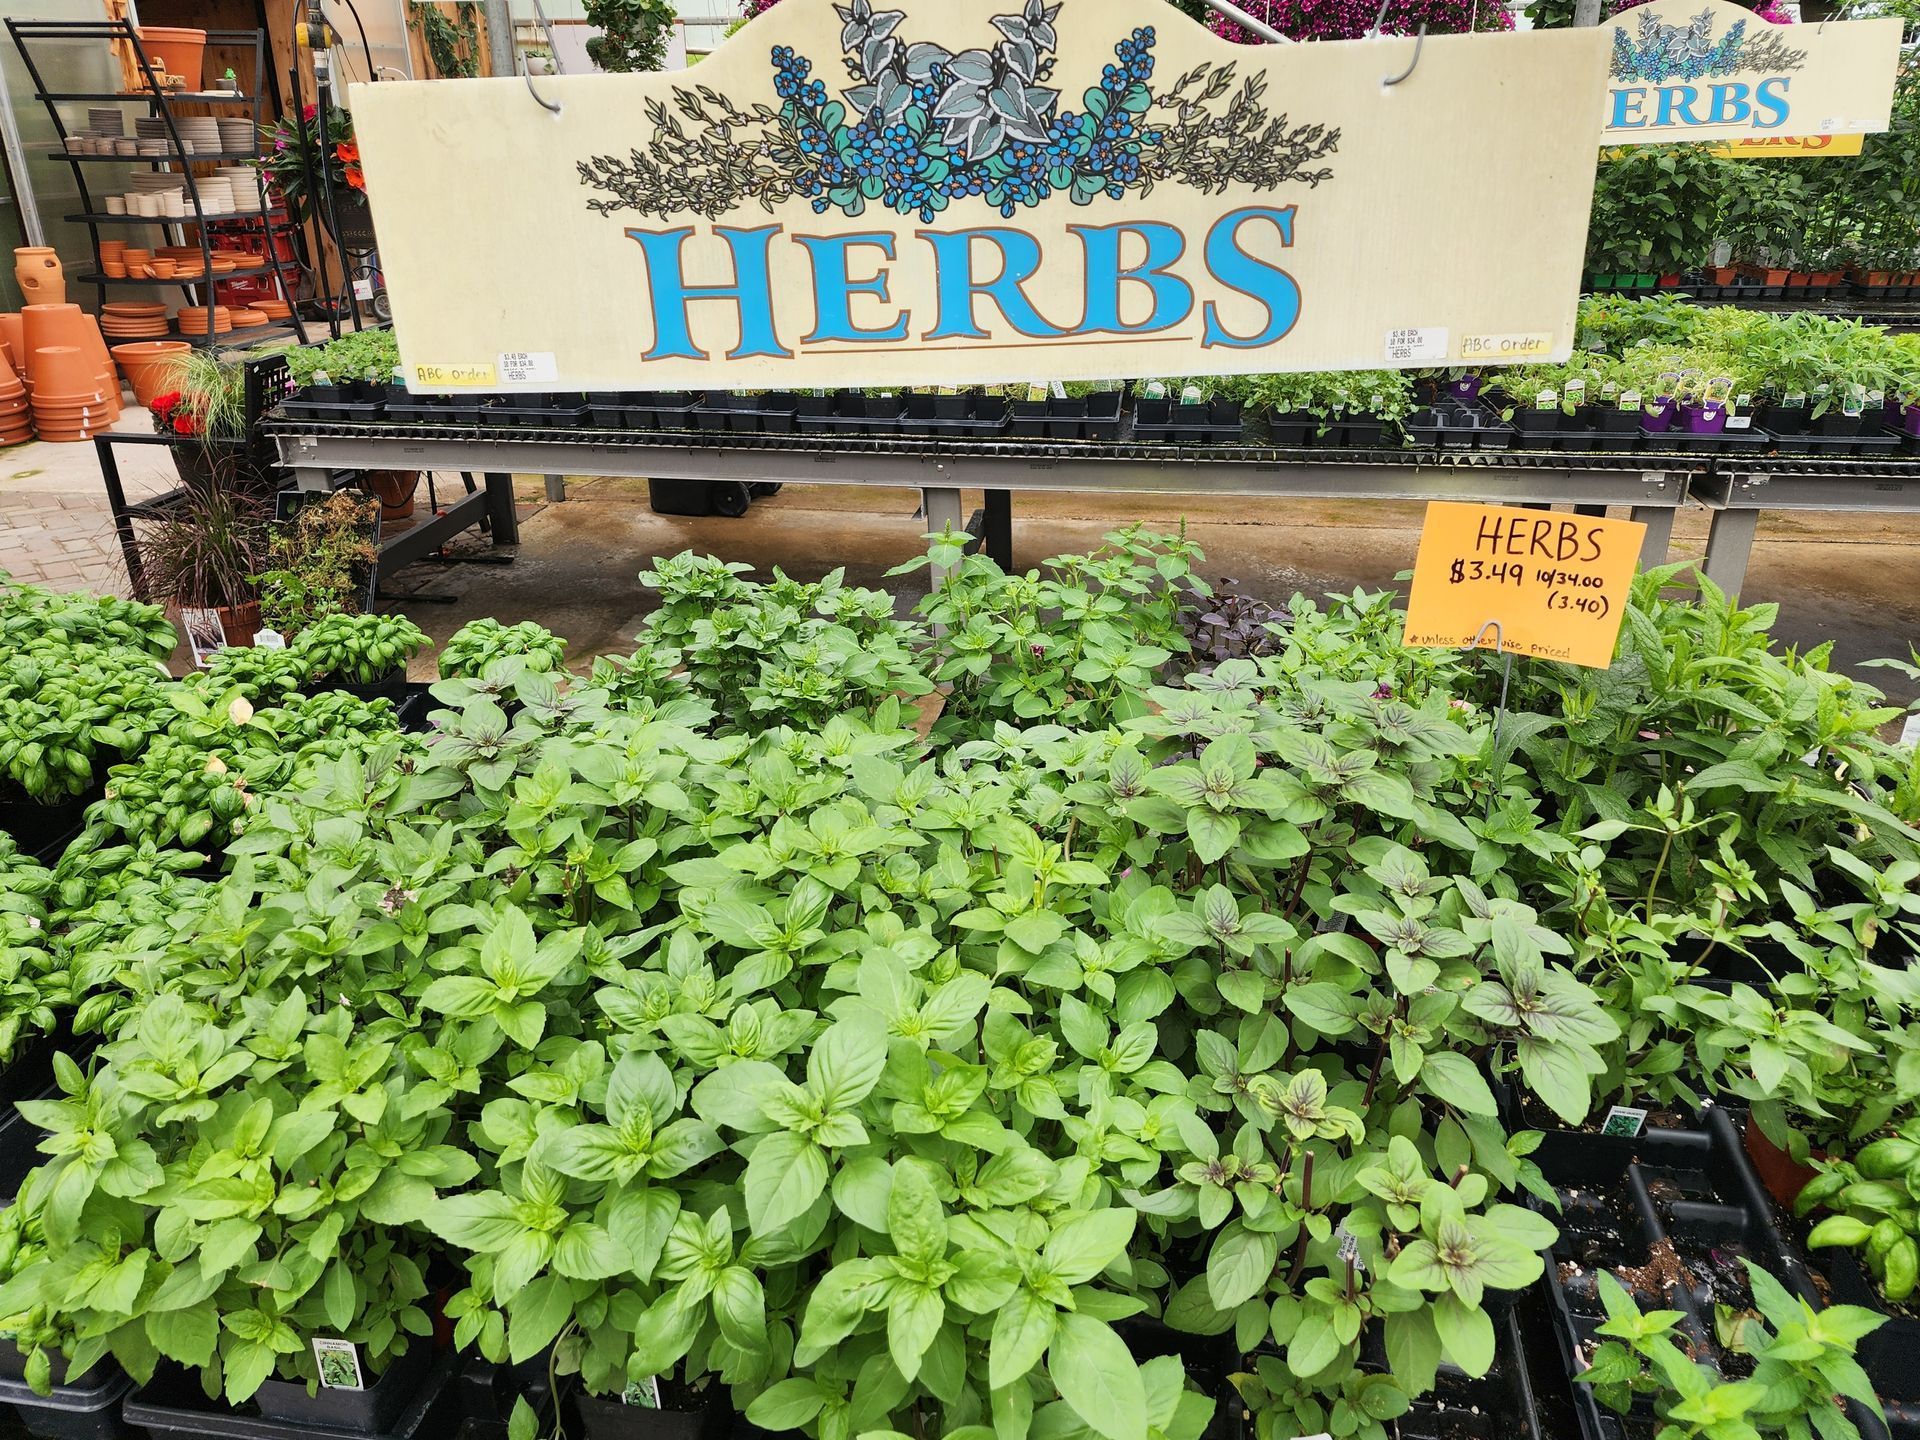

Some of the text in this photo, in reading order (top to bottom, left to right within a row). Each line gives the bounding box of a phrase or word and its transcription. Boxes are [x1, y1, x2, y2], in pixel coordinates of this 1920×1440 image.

[1601, 77, 1791, 132] ERBS
[624, 204, 1302, 362] HERBS
[1391, 348, 1411, 359] HERBS
[1463, 338, 1492, 353] ABC
[417, 367, 443, 381] ABC
[508, 370, 527, 380] HERBS
[1476, 515, 1604, 562] HERBS
[1450, 558, 1604, 589] $3.49 10/34.00
[1547, 591, 1609, 620] (3.40)
